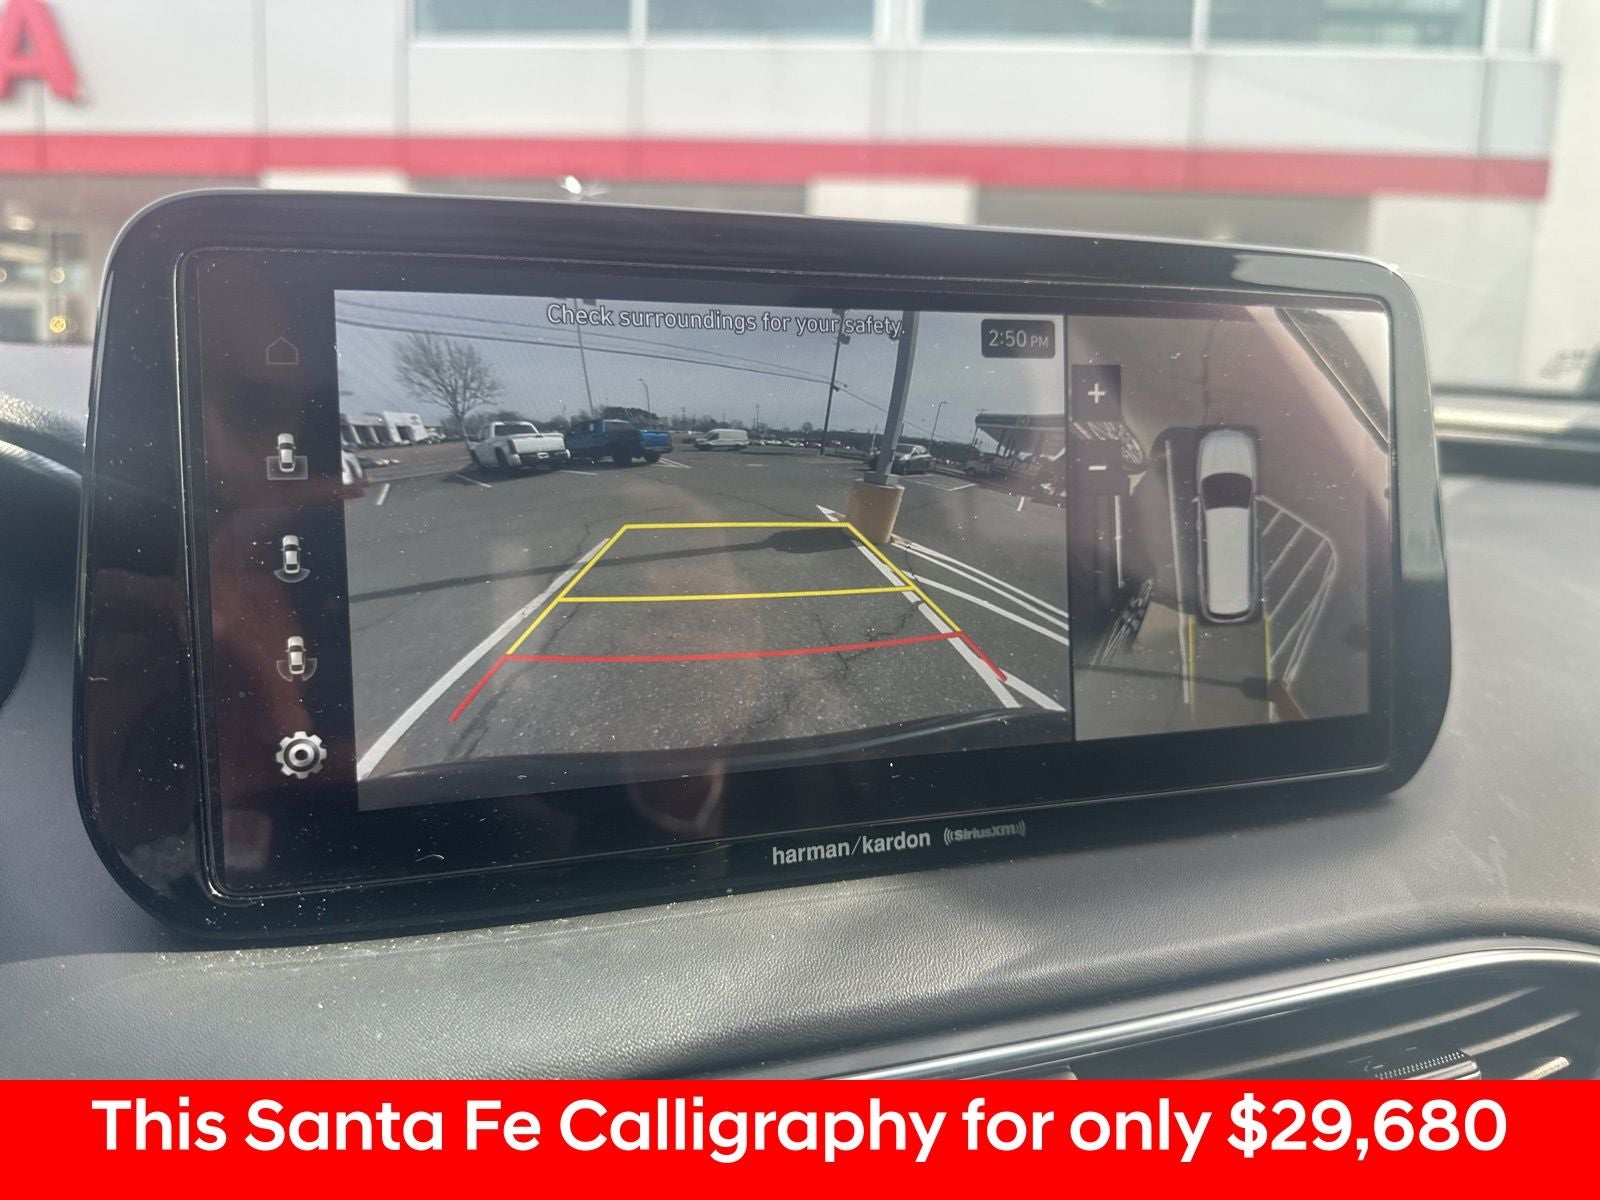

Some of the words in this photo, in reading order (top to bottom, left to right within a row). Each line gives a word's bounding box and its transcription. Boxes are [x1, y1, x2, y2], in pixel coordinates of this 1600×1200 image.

[547, 303, 614, 326] Check
[619, 309, 757, 333] surroundings
[762, 311, 791, 331] for
[797, 316, 838, 336] your
[845, 315, 905, 339] safety.
[989, 329, 1027, 348] 2:50
[1030, 335, 1049, 348] PM
